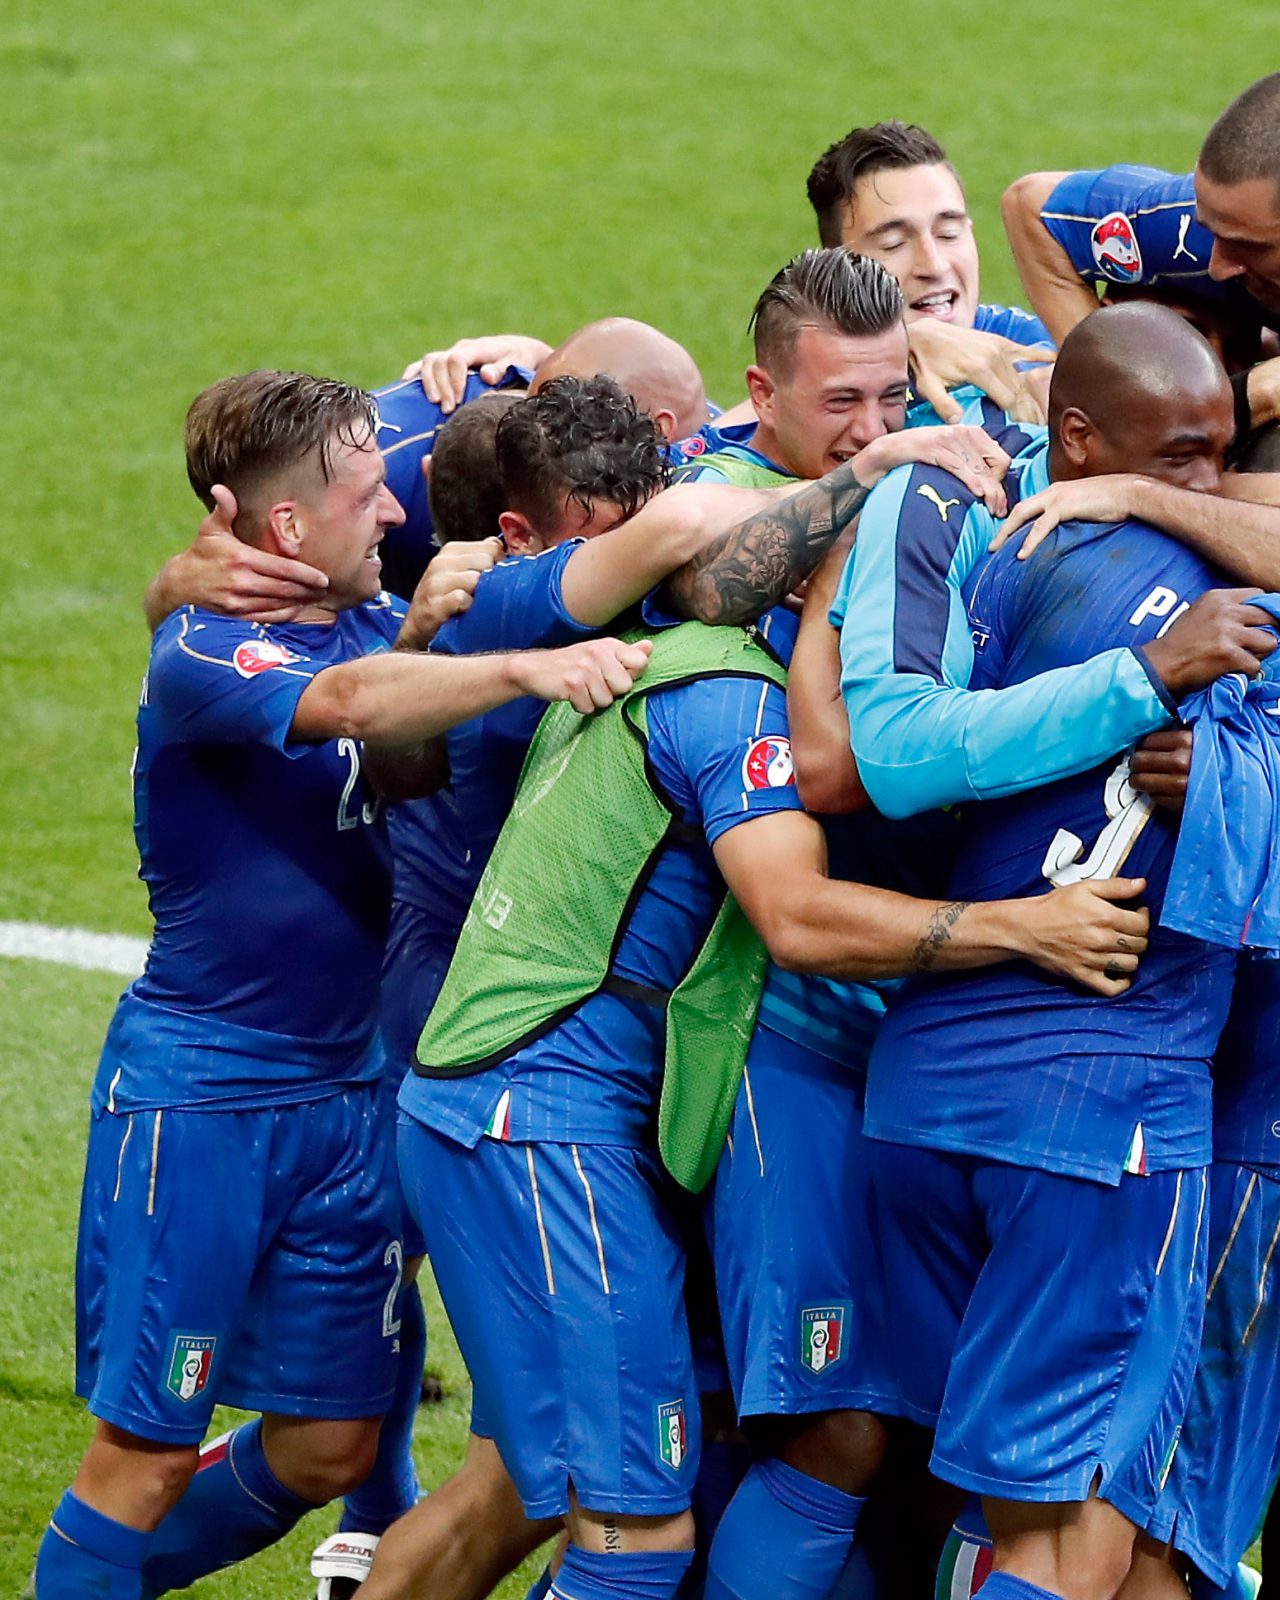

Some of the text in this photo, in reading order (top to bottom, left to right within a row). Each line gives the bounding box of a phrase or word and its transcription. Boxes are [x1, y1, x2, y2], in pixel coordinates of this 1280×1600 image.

[337, 737, 379, 831] 2
[806, 1311, 837, 1321] ITALIA
[180, 1340, 211, 1350] ITALIA
